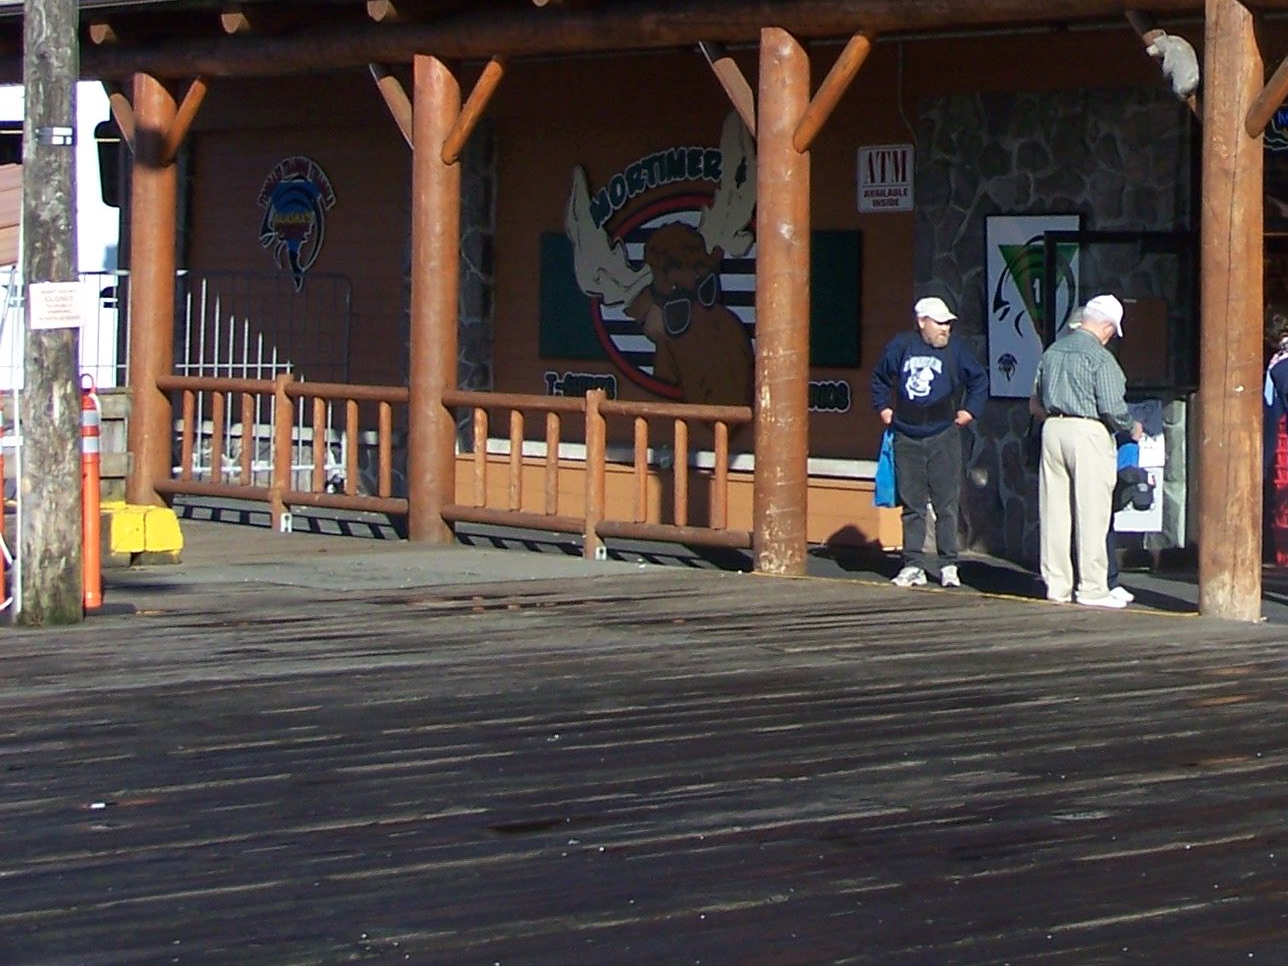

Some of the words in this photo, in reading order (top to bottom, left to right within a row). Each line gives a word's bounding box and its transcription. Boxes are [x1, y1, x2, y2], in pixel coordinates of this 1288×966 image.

[863, 150, 908, 184] ATM
[589, 146, 722, 230] MORTIMER
[863, 187, 908, 198] AVAILABLE
